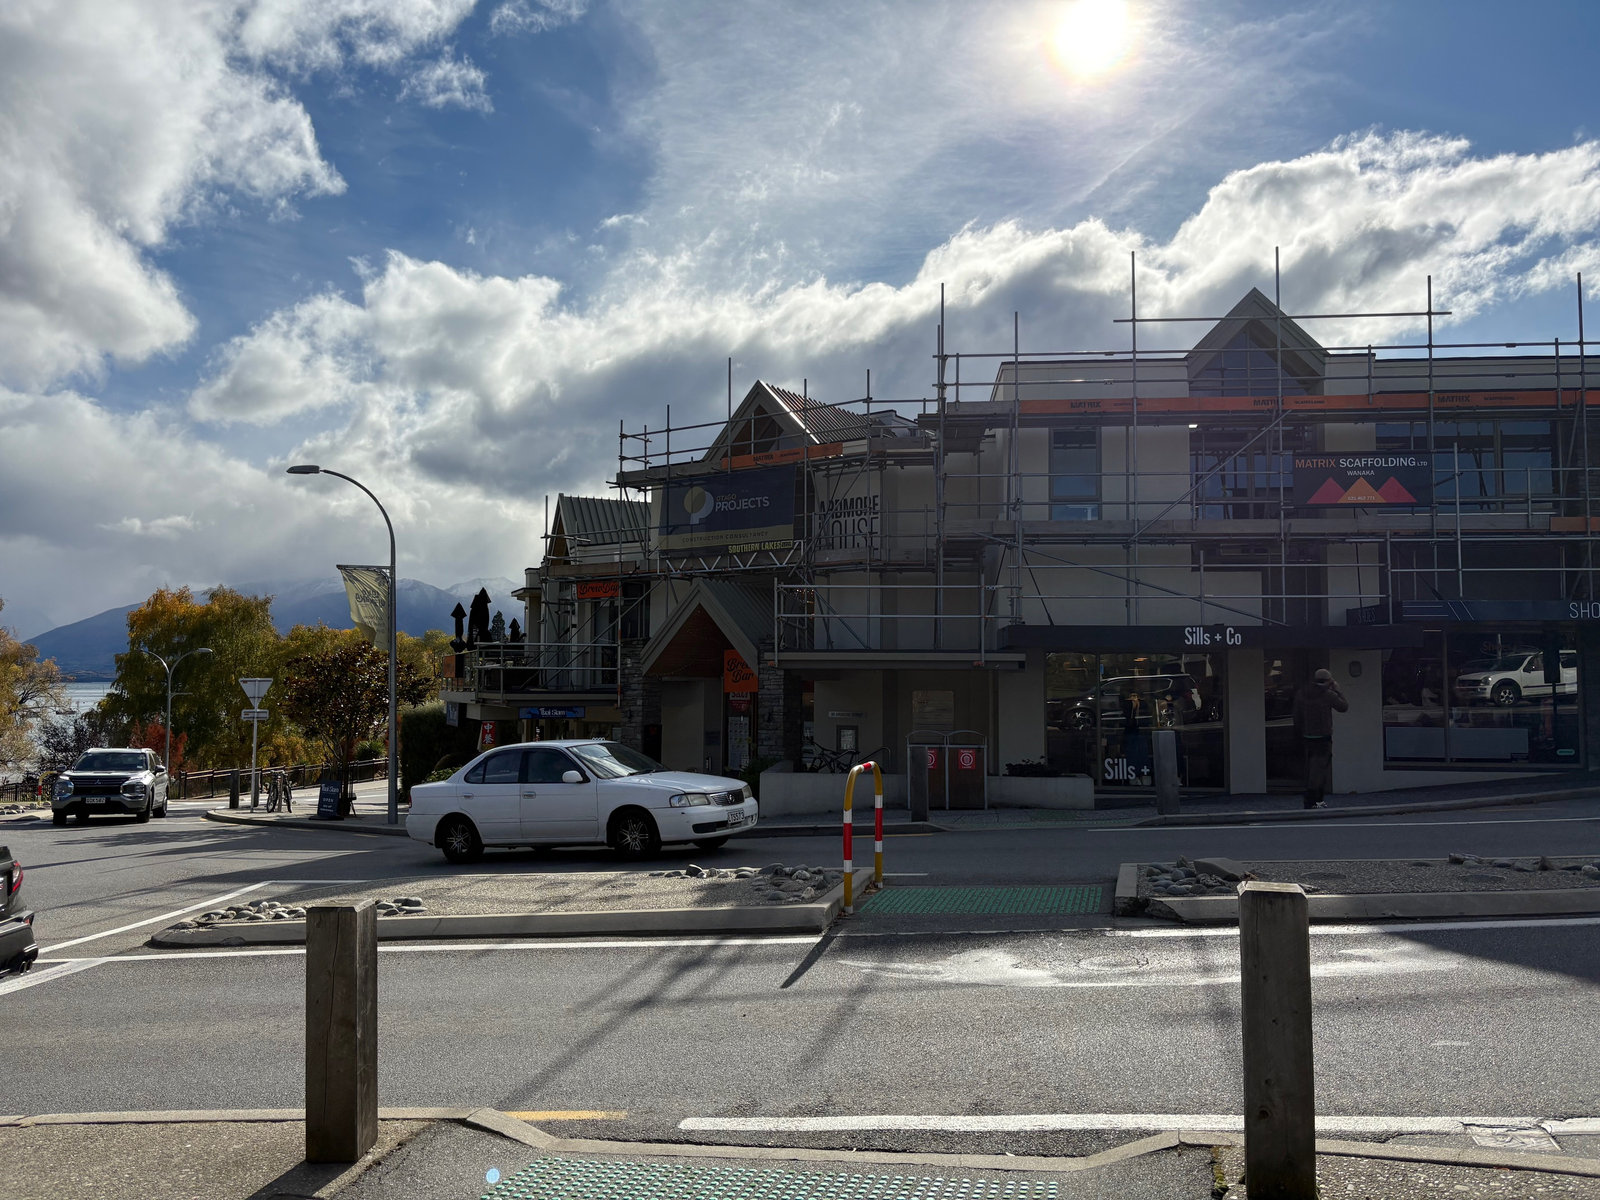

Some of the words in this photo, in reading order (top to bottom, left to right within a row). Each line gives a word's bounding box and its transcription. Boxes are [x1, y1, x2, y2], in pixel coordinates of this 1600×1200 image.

[1295, 458, 1336, 468] MATRIX
[1339, 457, 1416, 468] SCAFFOLDING
[715, 496, 770, 512] PROJECTS
[716, 493, 737, 501] OTAGO
[728, 543, 760, 554] SOUTHERN
[761, 541, 781, 551] LAKES
[1184, 627, 1211, 645] Sills
[1214, 633, 1222, 642] +
[1226, 628, 1242, 645] Co
[727, 659, 750, 672] Bre
[732, 669, 754, 684] Bar
[1104, 758, 1136, 780] Sills
